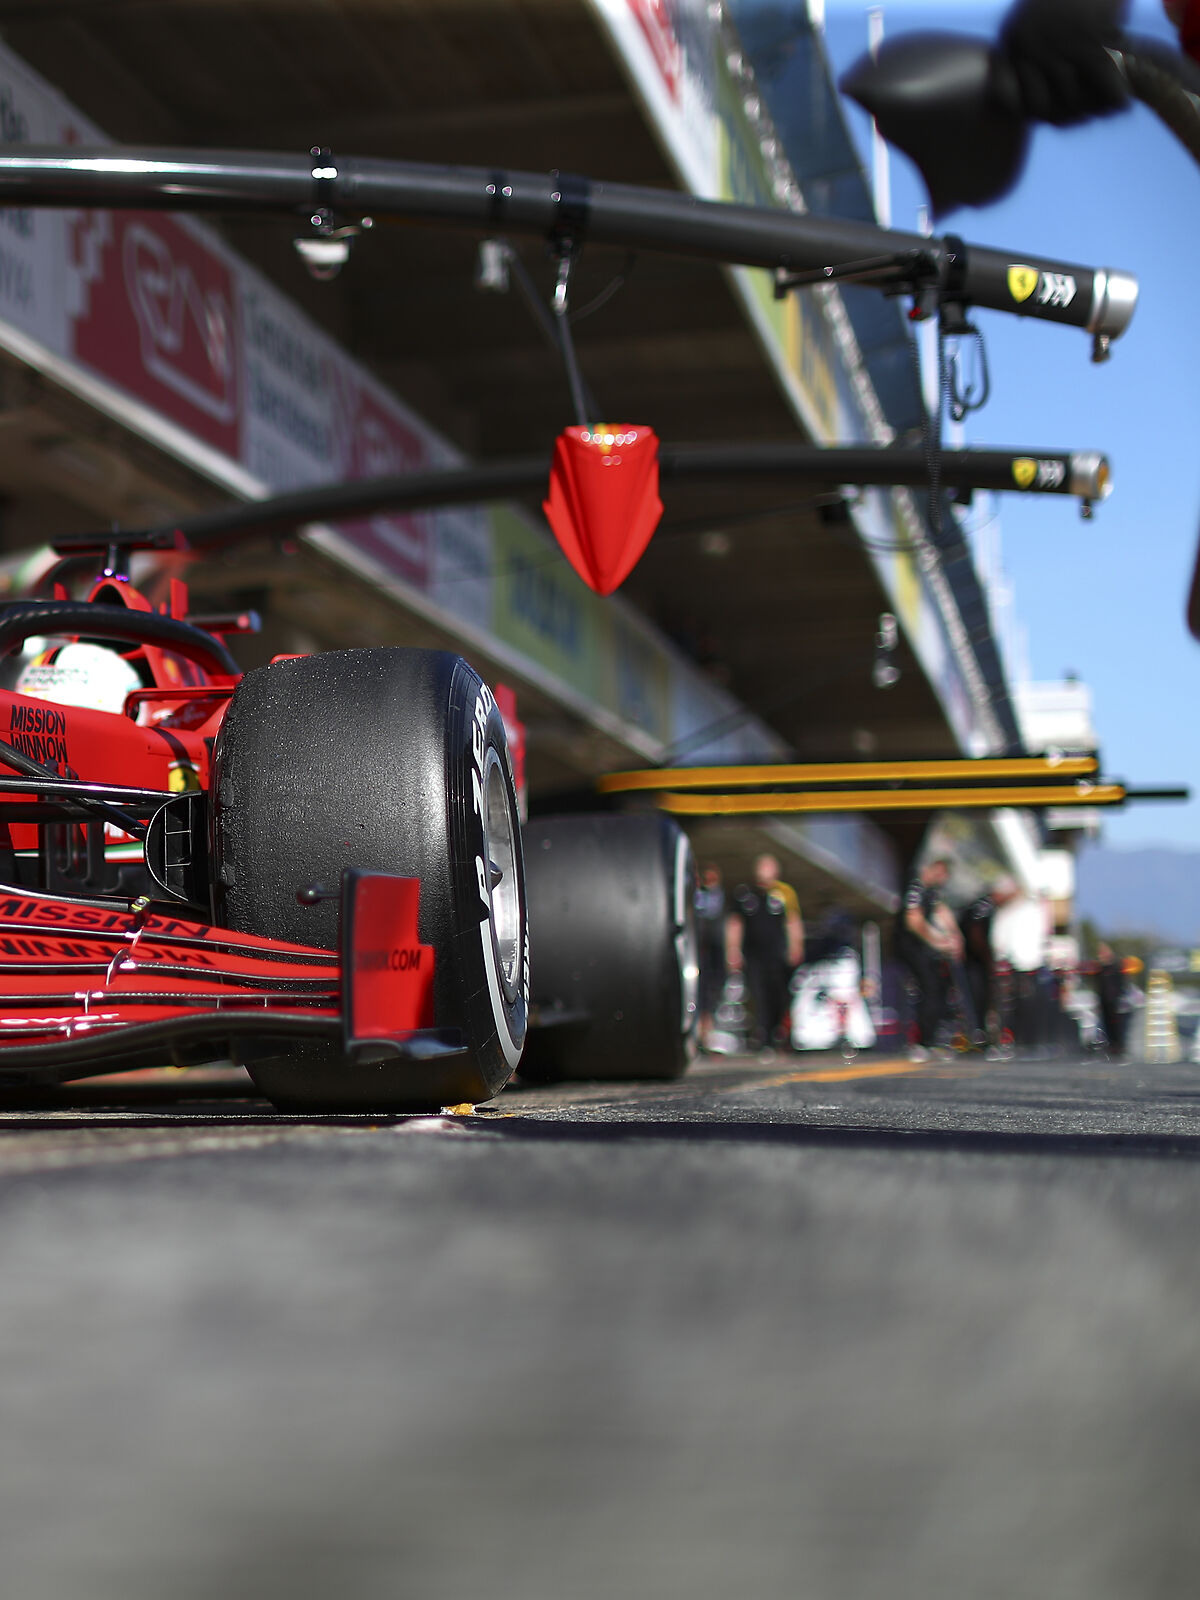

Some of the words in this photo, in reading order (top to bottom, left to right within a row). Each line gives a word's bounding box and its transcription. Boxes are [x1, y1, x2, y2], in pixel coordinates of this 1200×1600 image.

[10, 704, 66, 736] MISSION
[10, 733, 68, 764] WINNOW
[471, 682, 498, 828] ZERO
